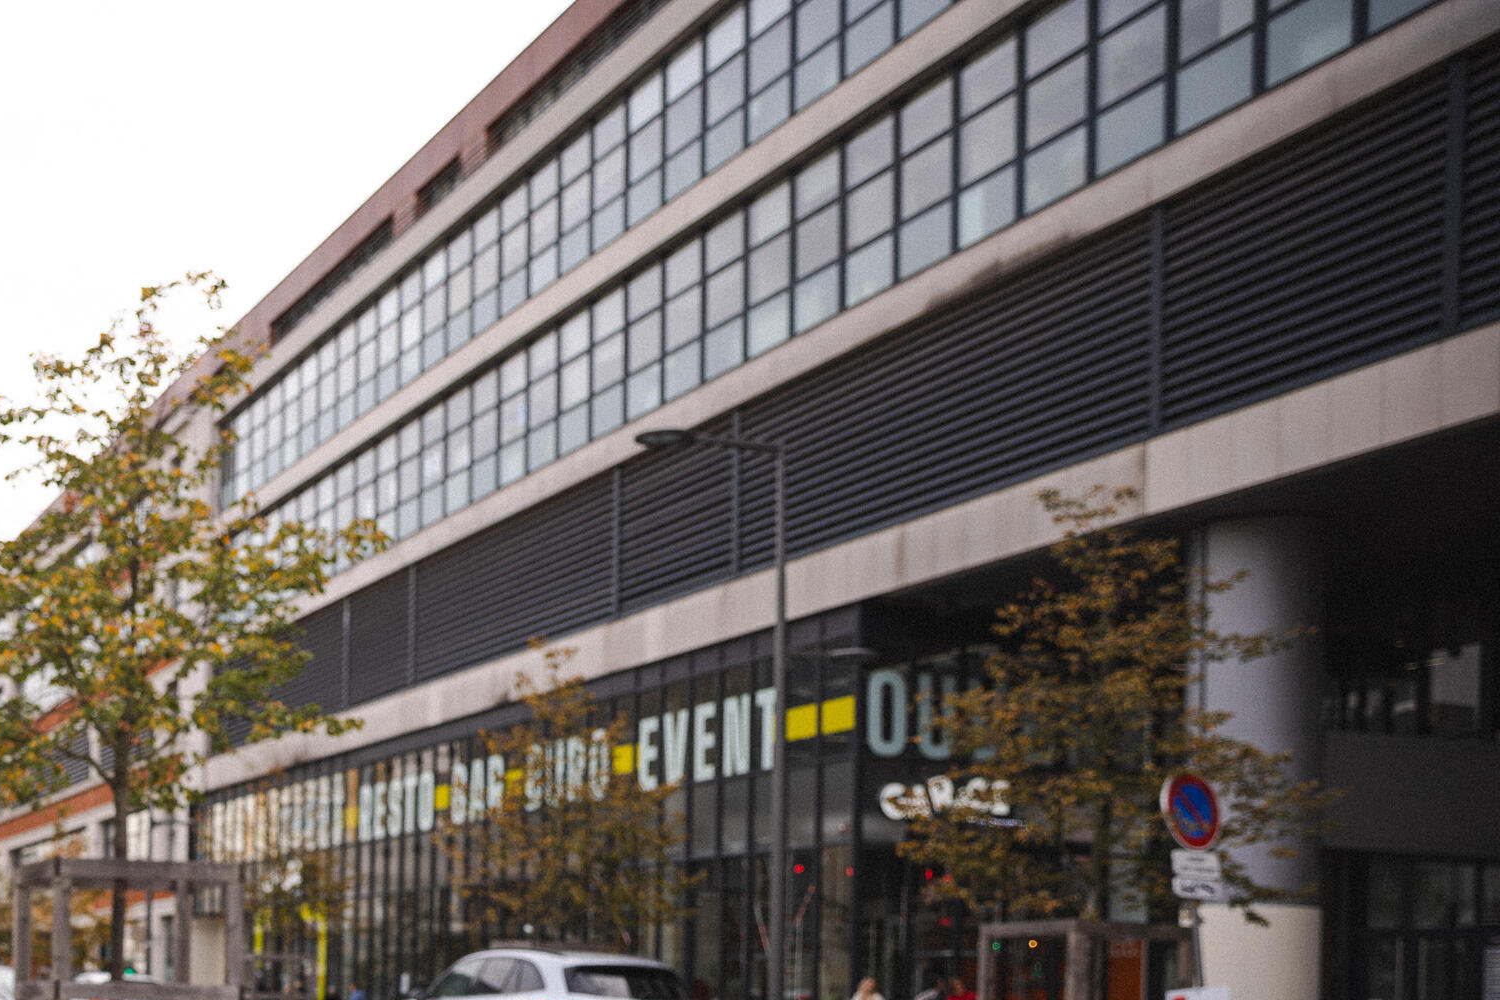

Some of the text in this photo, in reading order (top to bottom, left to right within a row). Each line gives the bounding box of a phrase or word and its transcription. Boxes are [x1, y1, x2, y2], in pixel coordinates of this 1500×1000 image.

[358, 769, 434, 842] RESTO
[451, 754, 505, 825] BAR
[638, 686, 777, 792] EVENT
